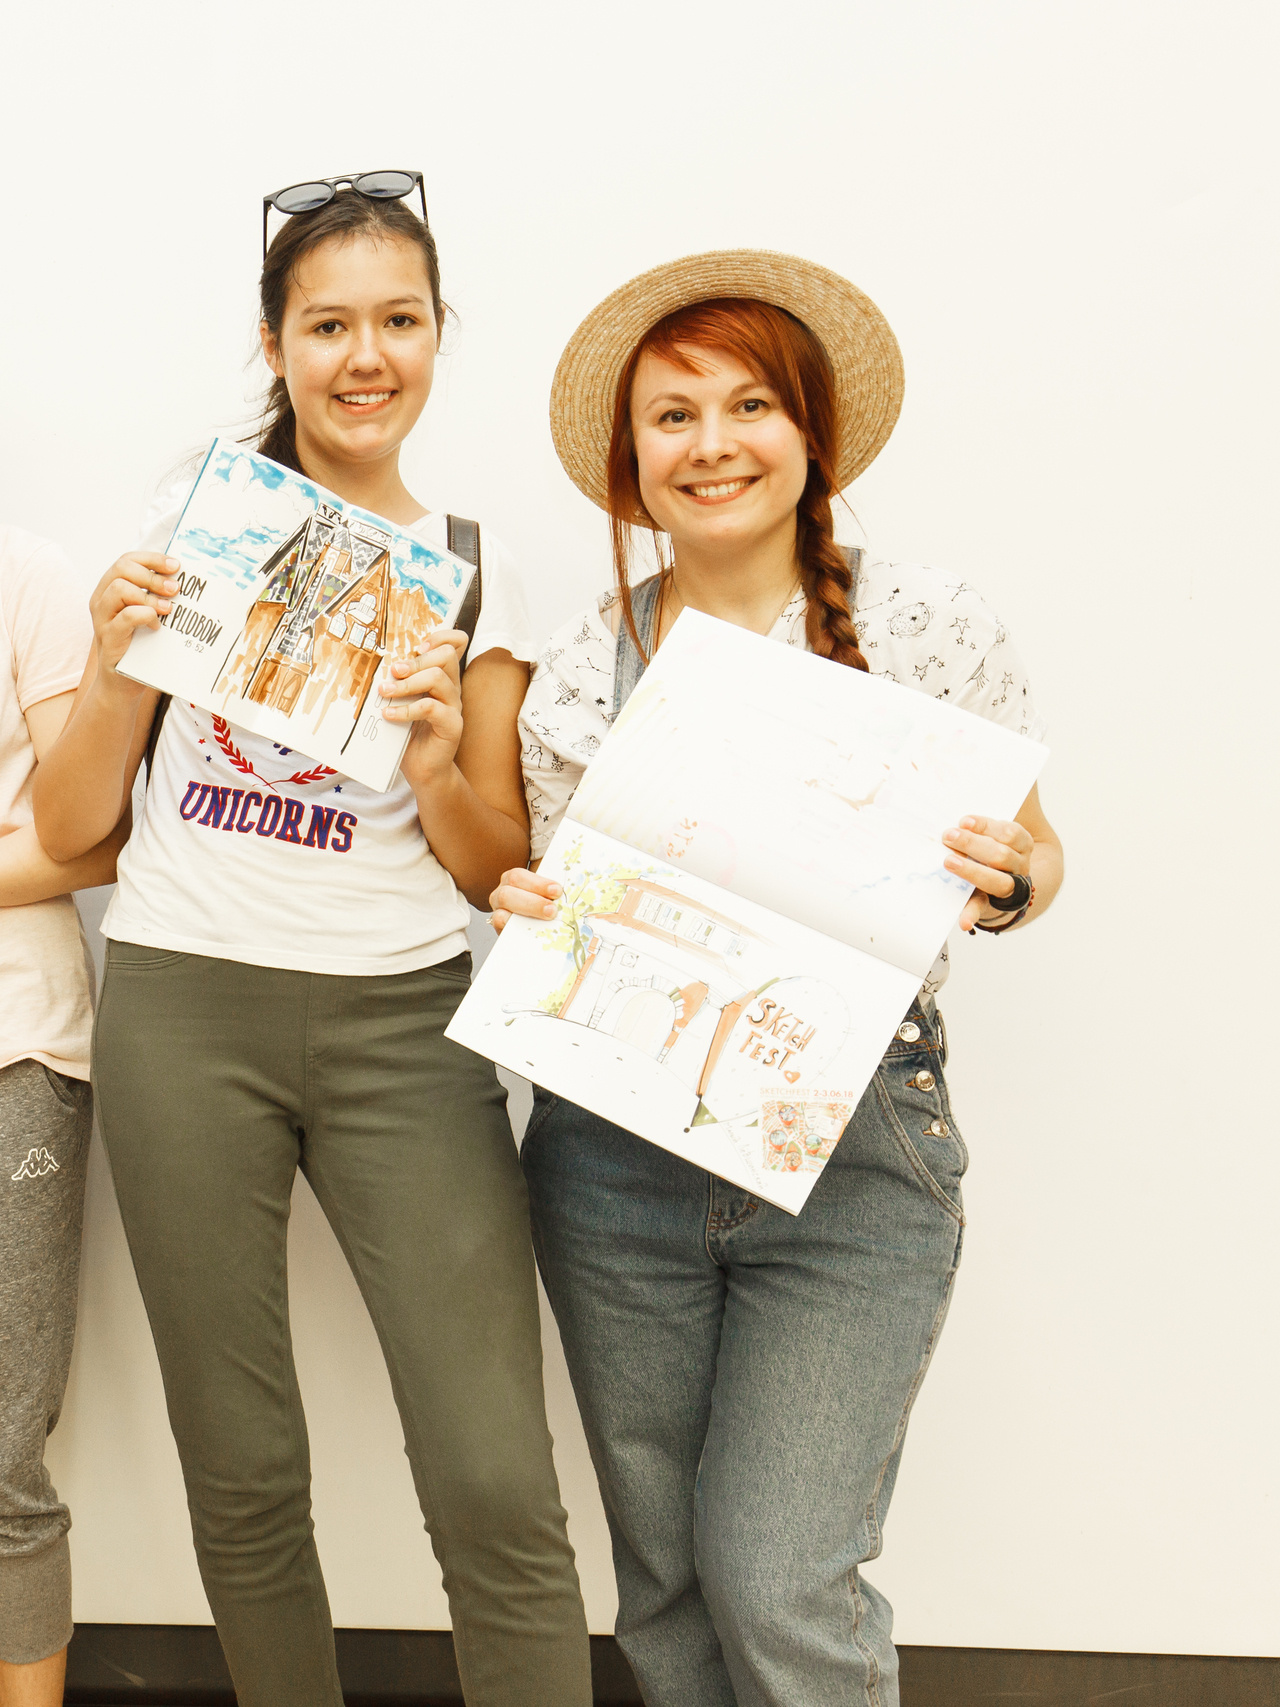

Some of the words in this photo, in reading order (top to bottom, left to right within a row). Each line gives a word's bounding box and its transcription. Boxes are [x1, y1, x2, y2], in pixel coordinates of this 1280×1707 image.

[157, 600, 223, 649] РЦОВОЙ
[179, 780, 359, 853] UNICORNS
[738, 1031, 797, 1071] FEST
[759, 1087, 811, 1097] SKETCHFEST
[813, 1089, 854, 1098] 2-3.06.18
